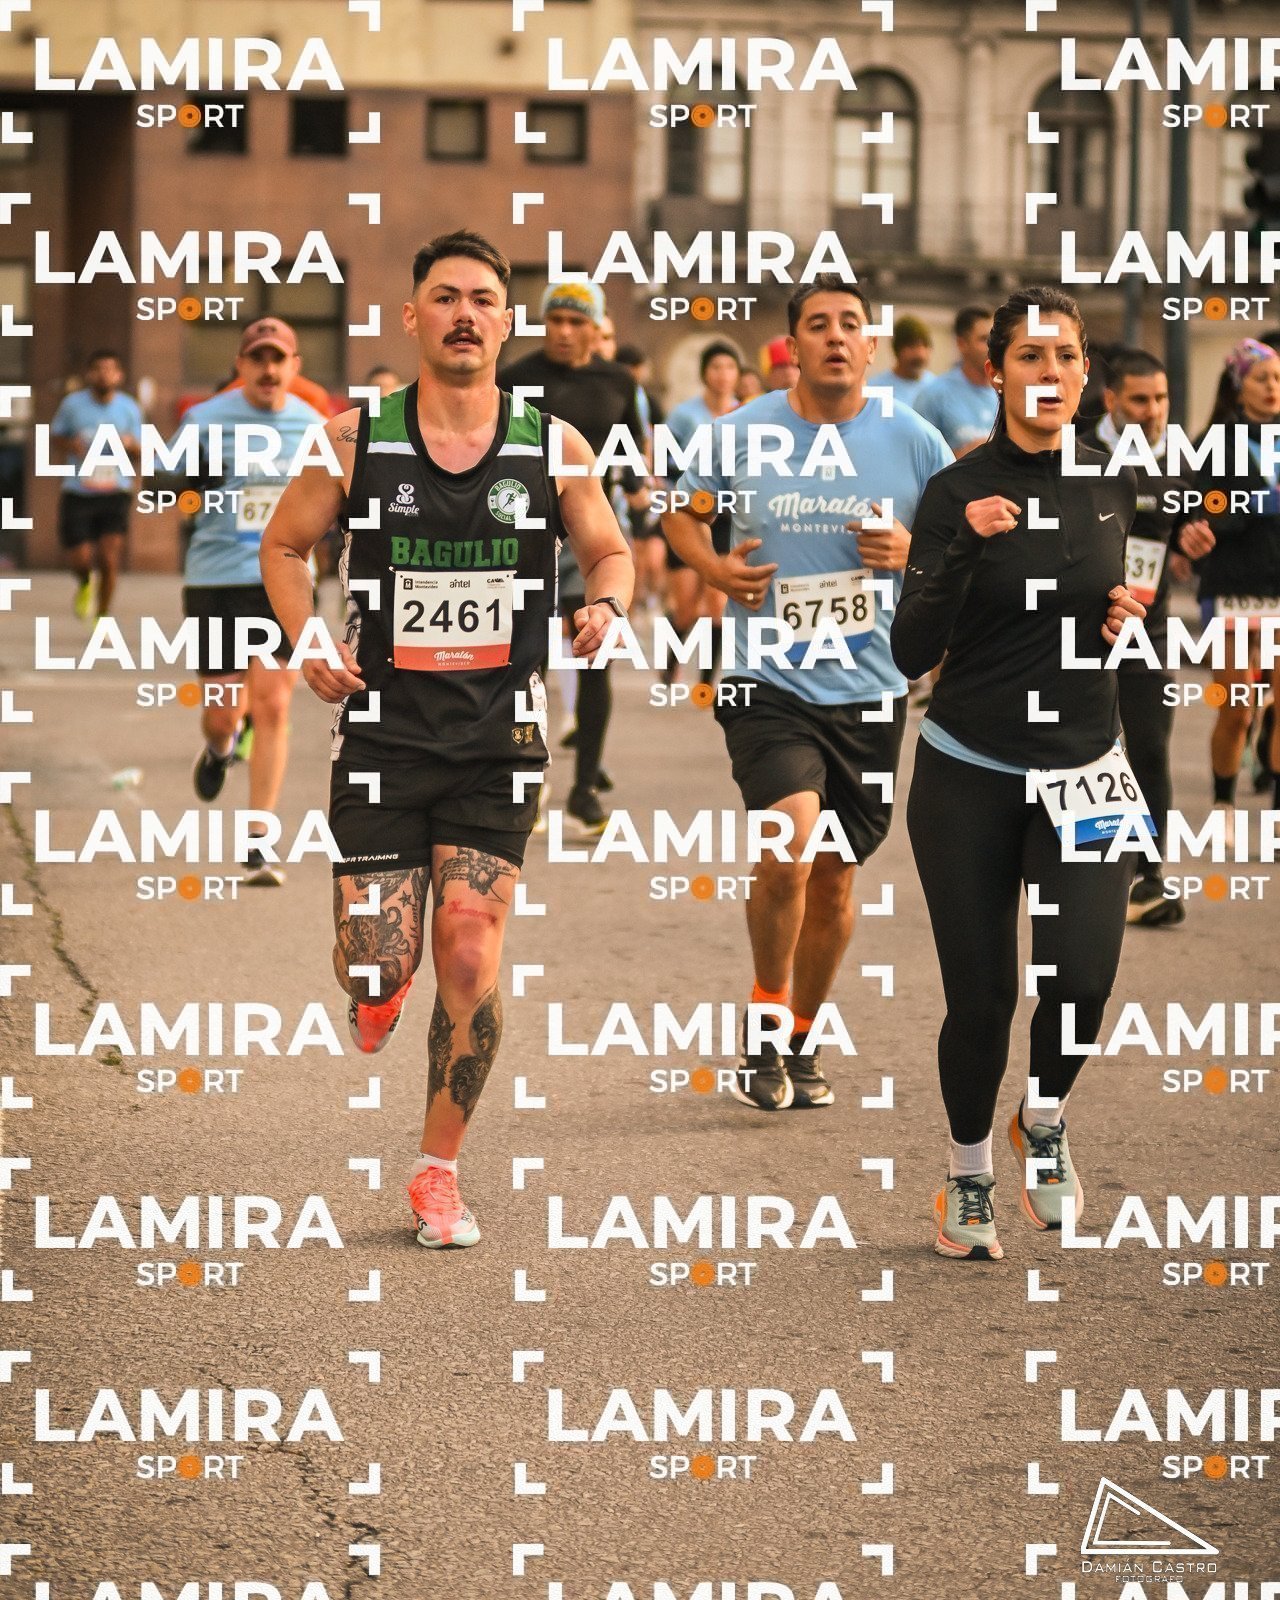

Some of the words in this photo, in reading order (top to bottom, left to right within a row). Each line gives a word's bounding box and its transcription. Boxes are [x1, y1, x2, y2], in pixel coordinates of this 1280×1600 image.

[243, 502, 272, 521] 67
[388, 502, 420, 516] Simple
[780, 523, 854, 534] MONTEVI
[390, 536, 519, 568] BAGULIO
[401, 598, 500, 633] 2461
[782, 593, 868, 631] 6758
[1045, 771, 1138, 811] 7126
